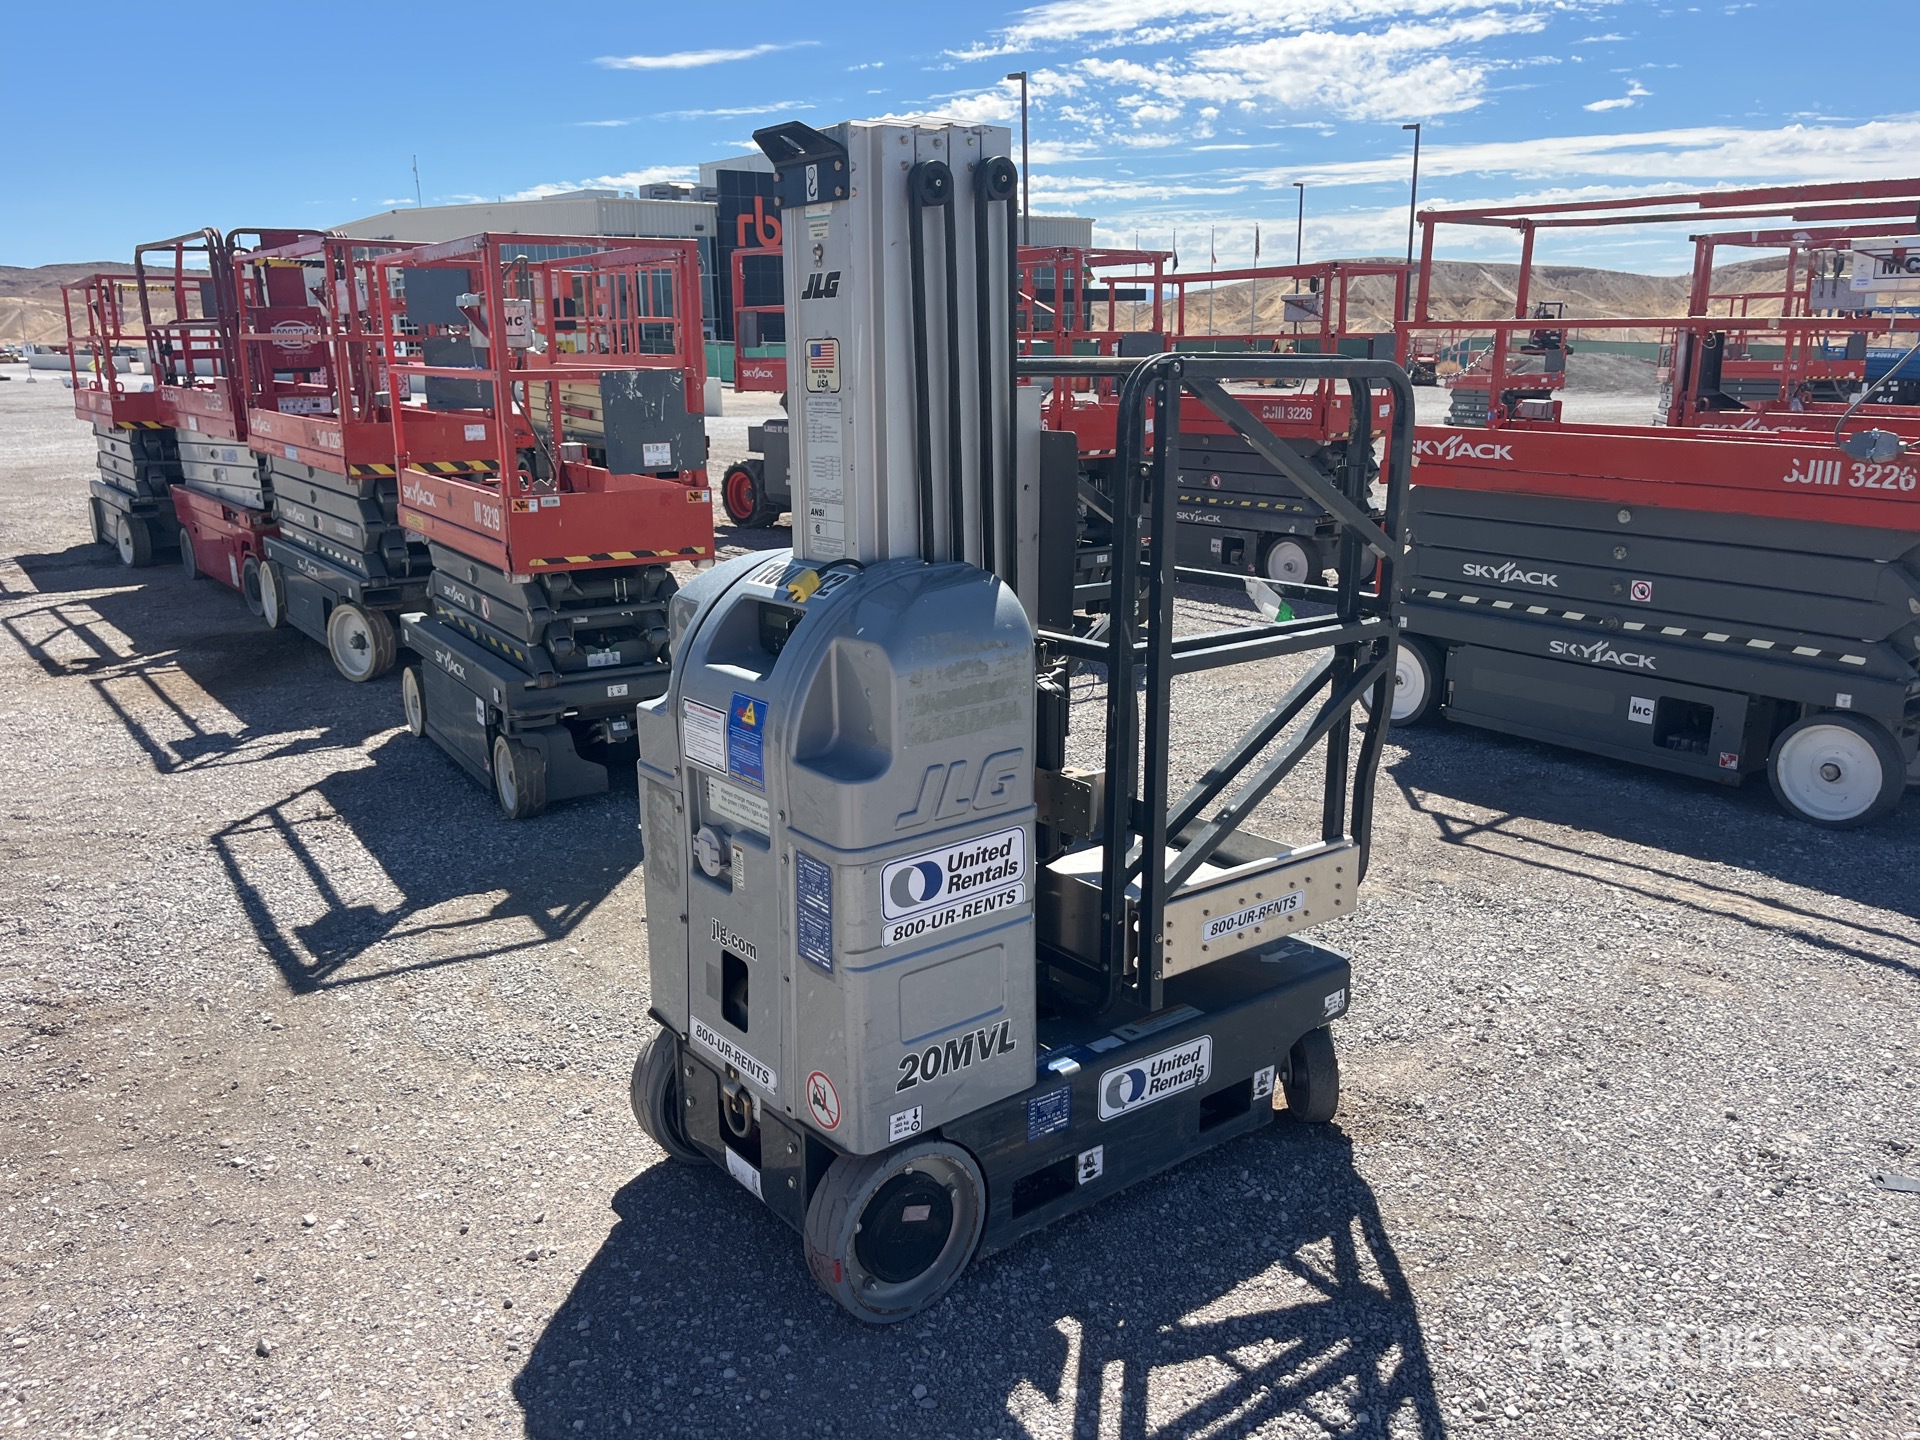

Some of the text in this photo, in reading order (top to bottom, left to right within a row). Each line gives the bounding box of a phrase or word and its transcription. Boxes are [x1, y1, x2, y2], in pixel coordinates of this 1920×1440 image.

[737, 196, 782, 247] rb
[801, 271, 842, 300] JLG
[742, 367, 773, 379] SKYJACK
[817, 379, 829, 388] USA
[1287, 406, 1313, 420] 3226
[1848, 462, 1917, 491] 3226
[402, 480, 437, 508] SKYJACK
[482, 504, 500, 531] 3219
[810, 507, 825, 517] ANSI
[1463, 561, 1559, 588] SKYJACK
[1549, 640, 1657, 670] SKYJACK
[1632, 704, 1651, 716] MC
[895, 747, 1024, 832] JLG
[947, 837, 1013, 873] United
[947, 859, 1018, 895] Rentals
[893, 889, 1017, 941] 800-UR-RENTS
[1210, 896, 1297, 936] 800-UR-RENTS
[711, 918, 757, 961] jlg.com
[695, 1024, 770, 1085] 800-UR-RENTS
[895, 1019, 1017, 1094] 20MVL
[1150, 1045, 1202, 1078] United
[1149, 1063, 1205, 1096] Rentals
